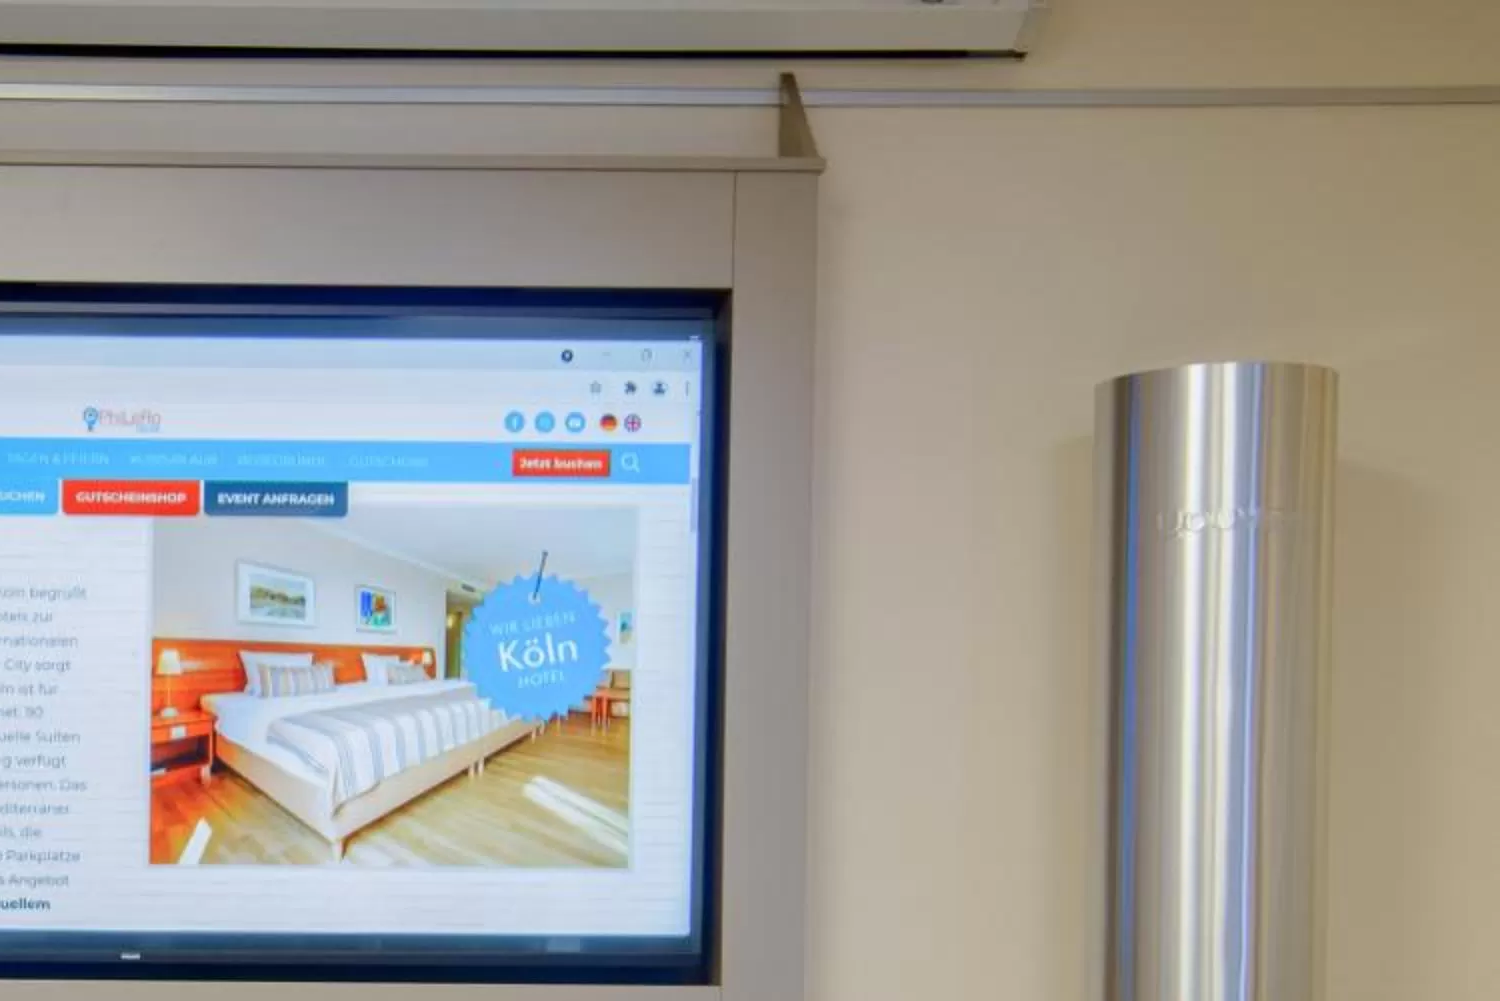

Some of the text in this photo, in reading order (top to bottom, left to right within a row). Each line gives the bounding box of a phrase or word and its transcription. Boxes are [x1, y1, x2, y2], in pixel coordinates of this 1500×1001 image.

[520, 457, 604, 471] Jetzt buchen
[75, 491, 187, 505] GUTSCHEINSHOP
[216, 491, 336, 507] EVENT ANFRAGEN
[498, 631, 580, 673] Köln
